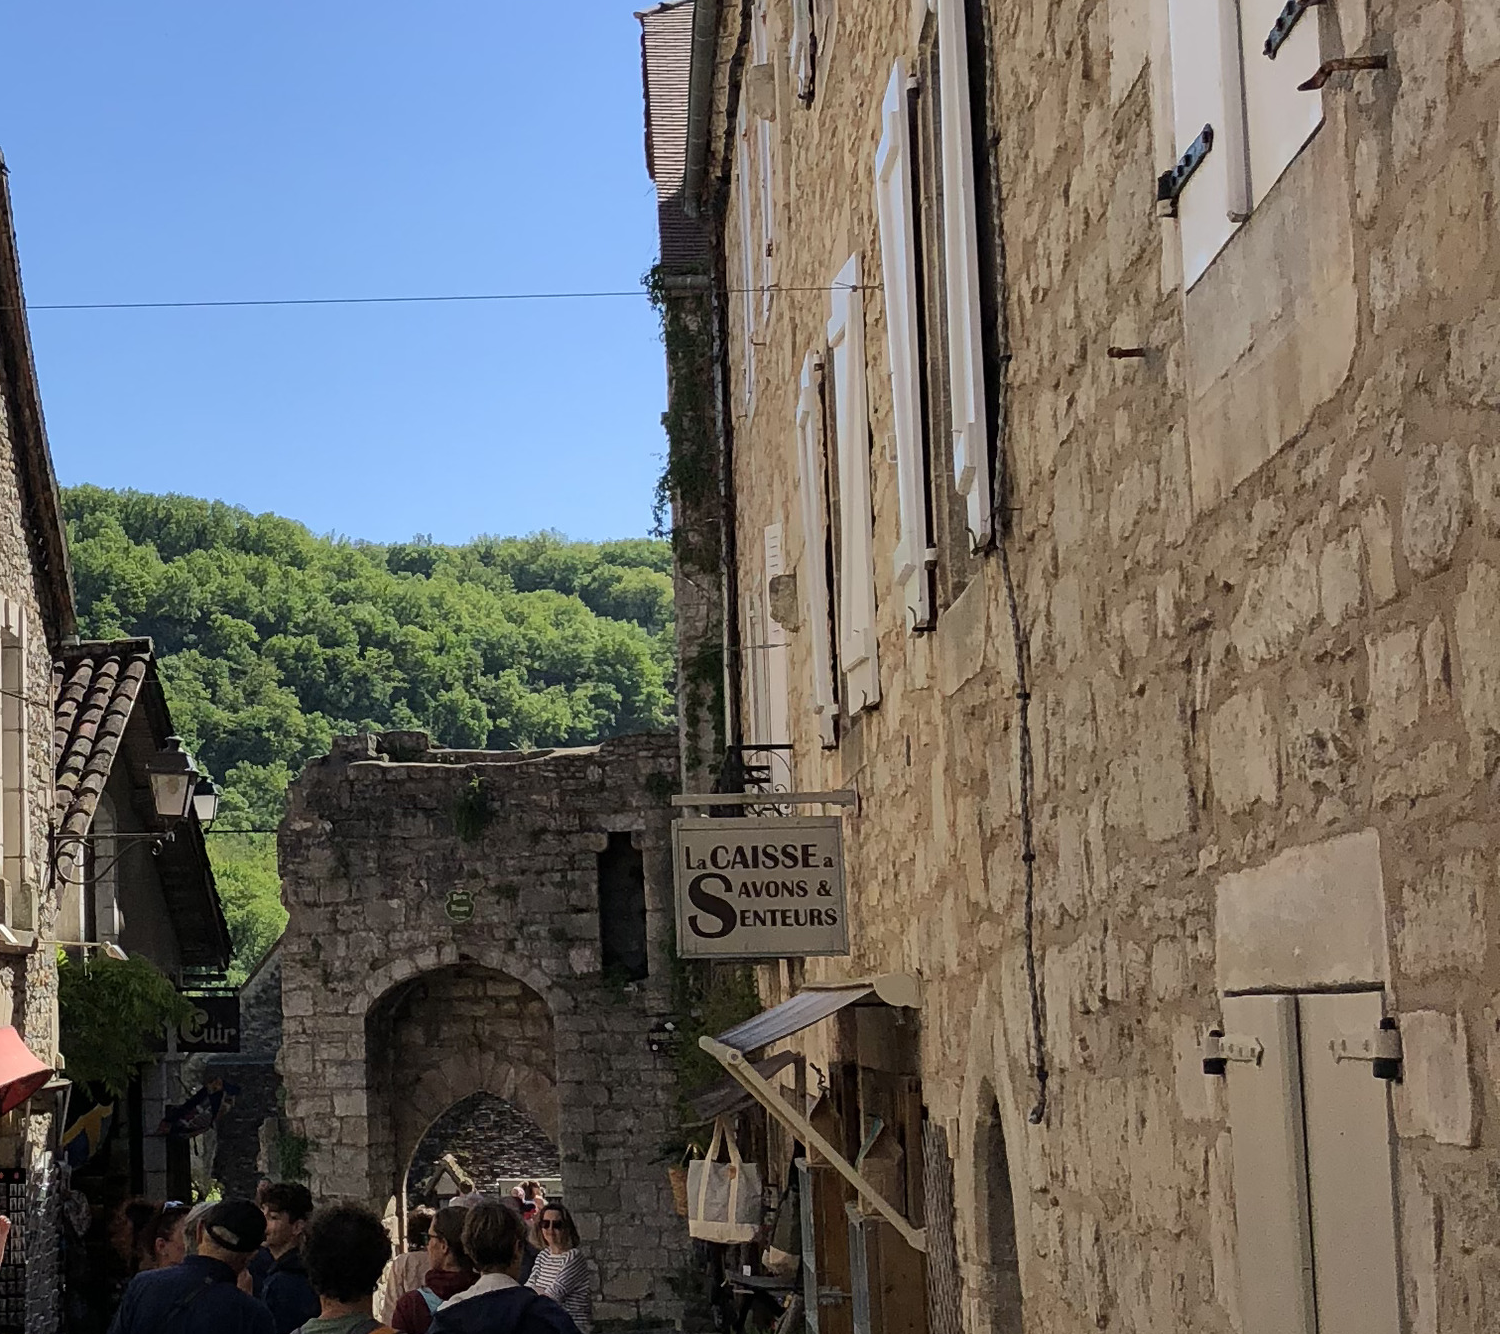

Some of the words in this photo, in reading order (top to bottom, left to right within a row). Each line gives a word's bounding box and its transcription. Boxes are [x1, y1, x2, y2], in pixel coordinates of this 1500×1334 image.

[685, 846, 707, 870] La
[710, 844, 820, 870] CAISSE
[816, 879, 833, 897] &
[181, 1007, 237, 1044] Cuir
